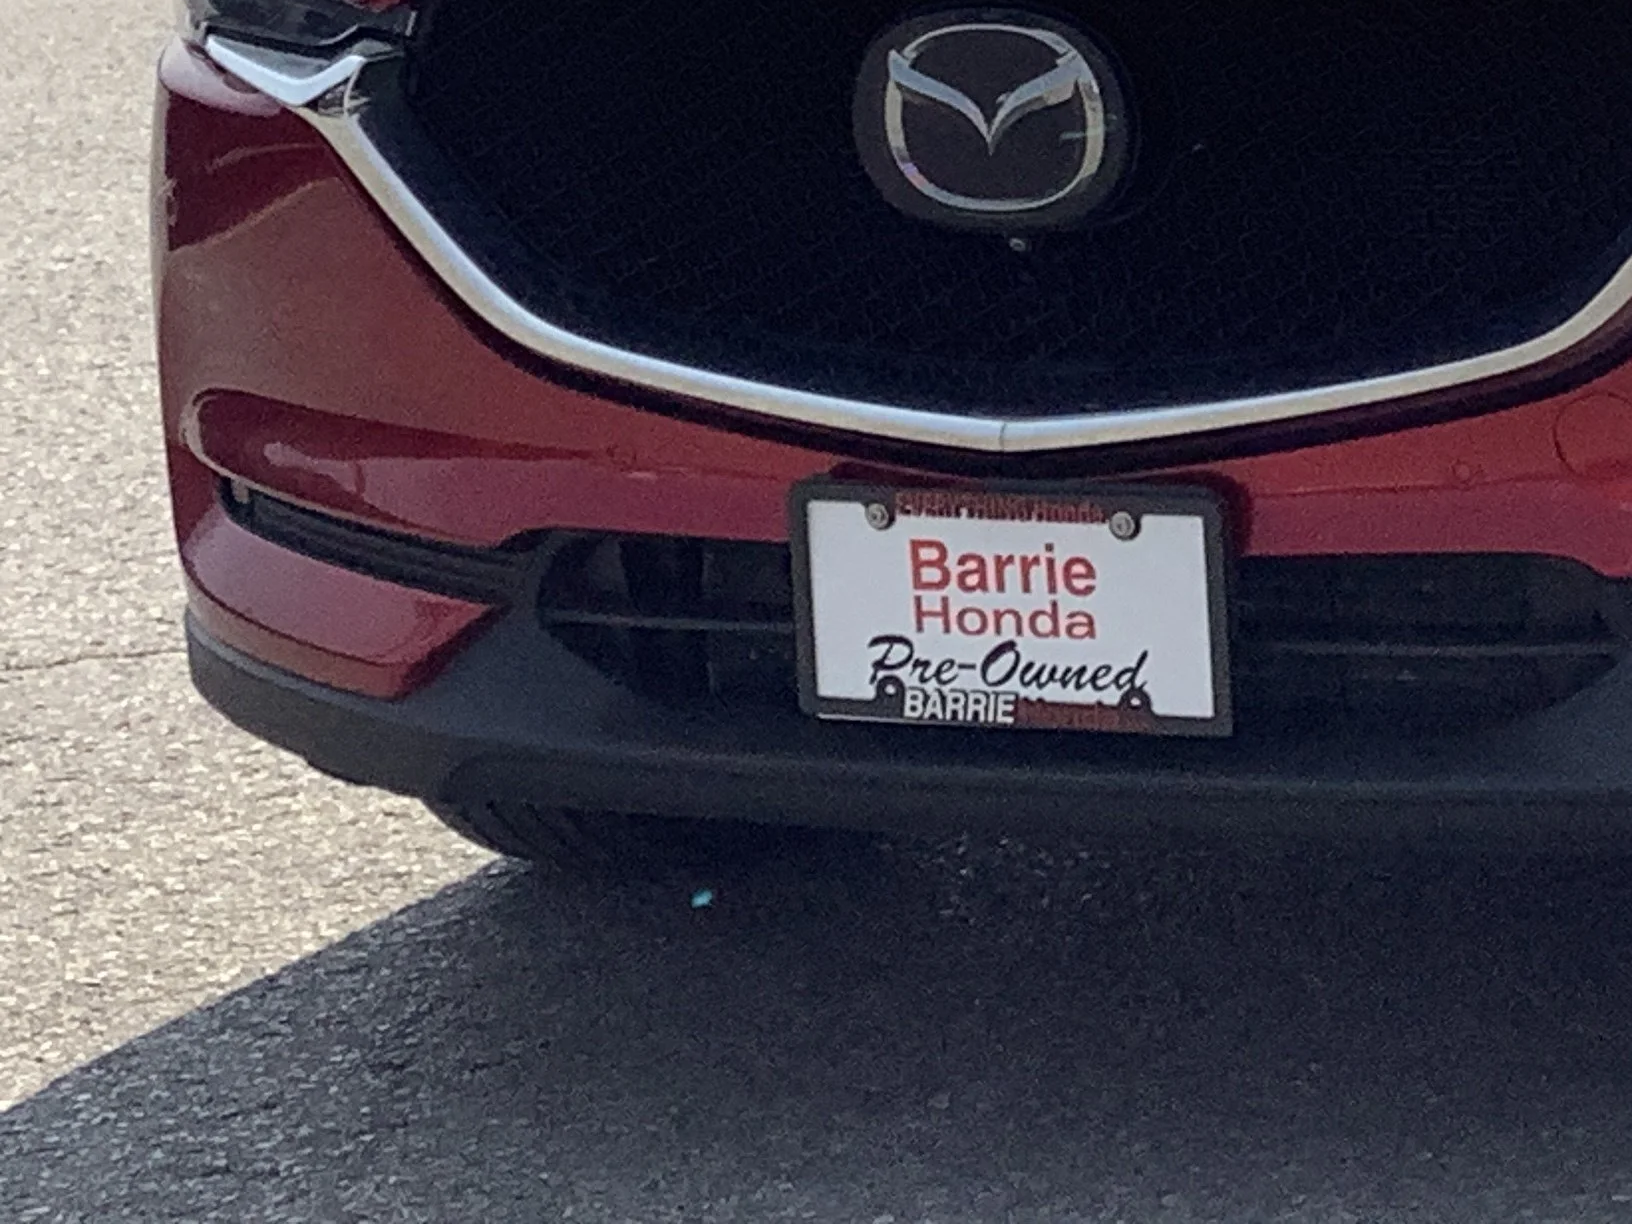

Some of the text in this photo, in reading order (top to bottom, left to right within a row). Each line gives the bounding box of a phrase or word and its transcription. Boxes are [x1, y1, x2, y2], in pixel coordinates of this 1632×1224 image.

[910, 539, 1097, 596] Barrie
[913, 595, 1097, 639] Honda
[867, 634, 1149, 692] Pre-Owned
[903, 686, 1017, 724] BARRIE
